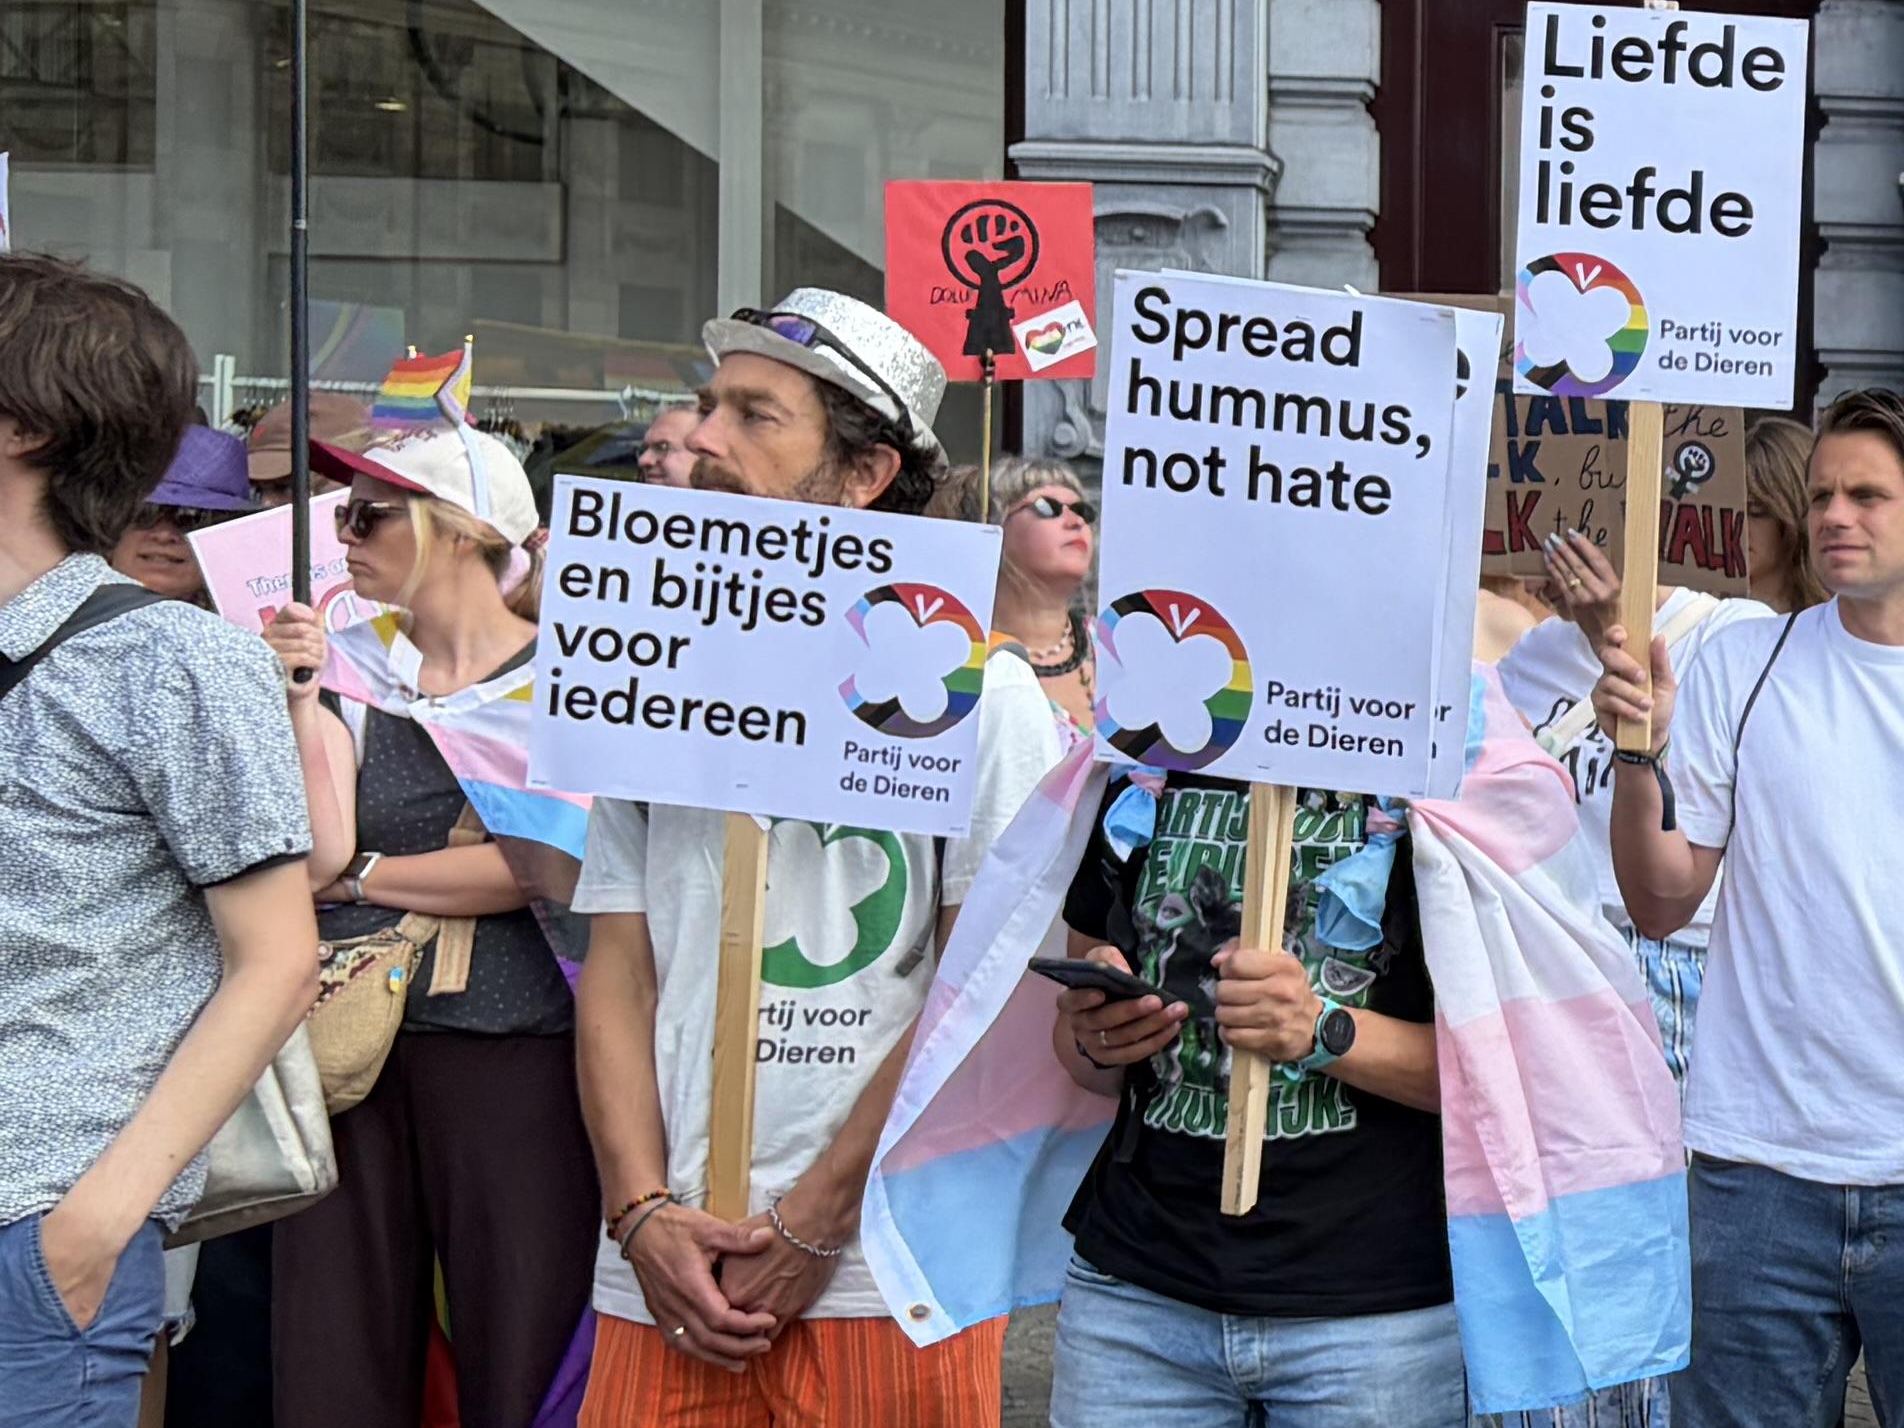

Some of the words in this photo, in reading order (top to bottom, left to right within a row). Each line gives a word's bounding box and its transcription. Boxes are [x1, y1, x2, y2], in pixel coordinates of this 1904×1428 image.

[1544, 14, 1785, 91] Liefde
[1540, 85, 1594, 152] is
[1537, 160, 1753, 237] liefde
[1010, 280, 1072, 305] MINA
[1131, 286, 1363, 367] Spread
[1661, 319, 1721, 347] Partij
[1729, 329, 1782, 346] voor
[1659, 350, 1688, 370] de
[1695, 352, 1772, 376] Dieren
[1128, 358, 1430, 459] hummus,
[1123, 446, 1226, 496] not
[1248, 445, 1391, 515] hate
[1579, 445, 1626, 490] bu
[569, 489, 893, 579] Bloemetjes
[1661, 500, 1748, 578] ALK
[560, 563, 629, 602] en
[652, 558, 826, 631] bijtjes
[553, 623, 691, 669] voor
[549, 668, 806, 745] iedereen
[1267, 681, 1340, 718] Partij
[1349, 697, 1415, 719] voor
[844, 741, 902, 771] Partij
[908, 754, 961, 772] voor
[1265, 719, 1299, 745] de
[1308, 724, 1403, 757] Dieren
[840, 772, 867, 792] de
[874, 775, 949, 802] Dieren
[757, 1000, 796, 1031] rtij
[803, 1009, 872, 1026] voor
[755, 1039, 856, 1065] Dieren
